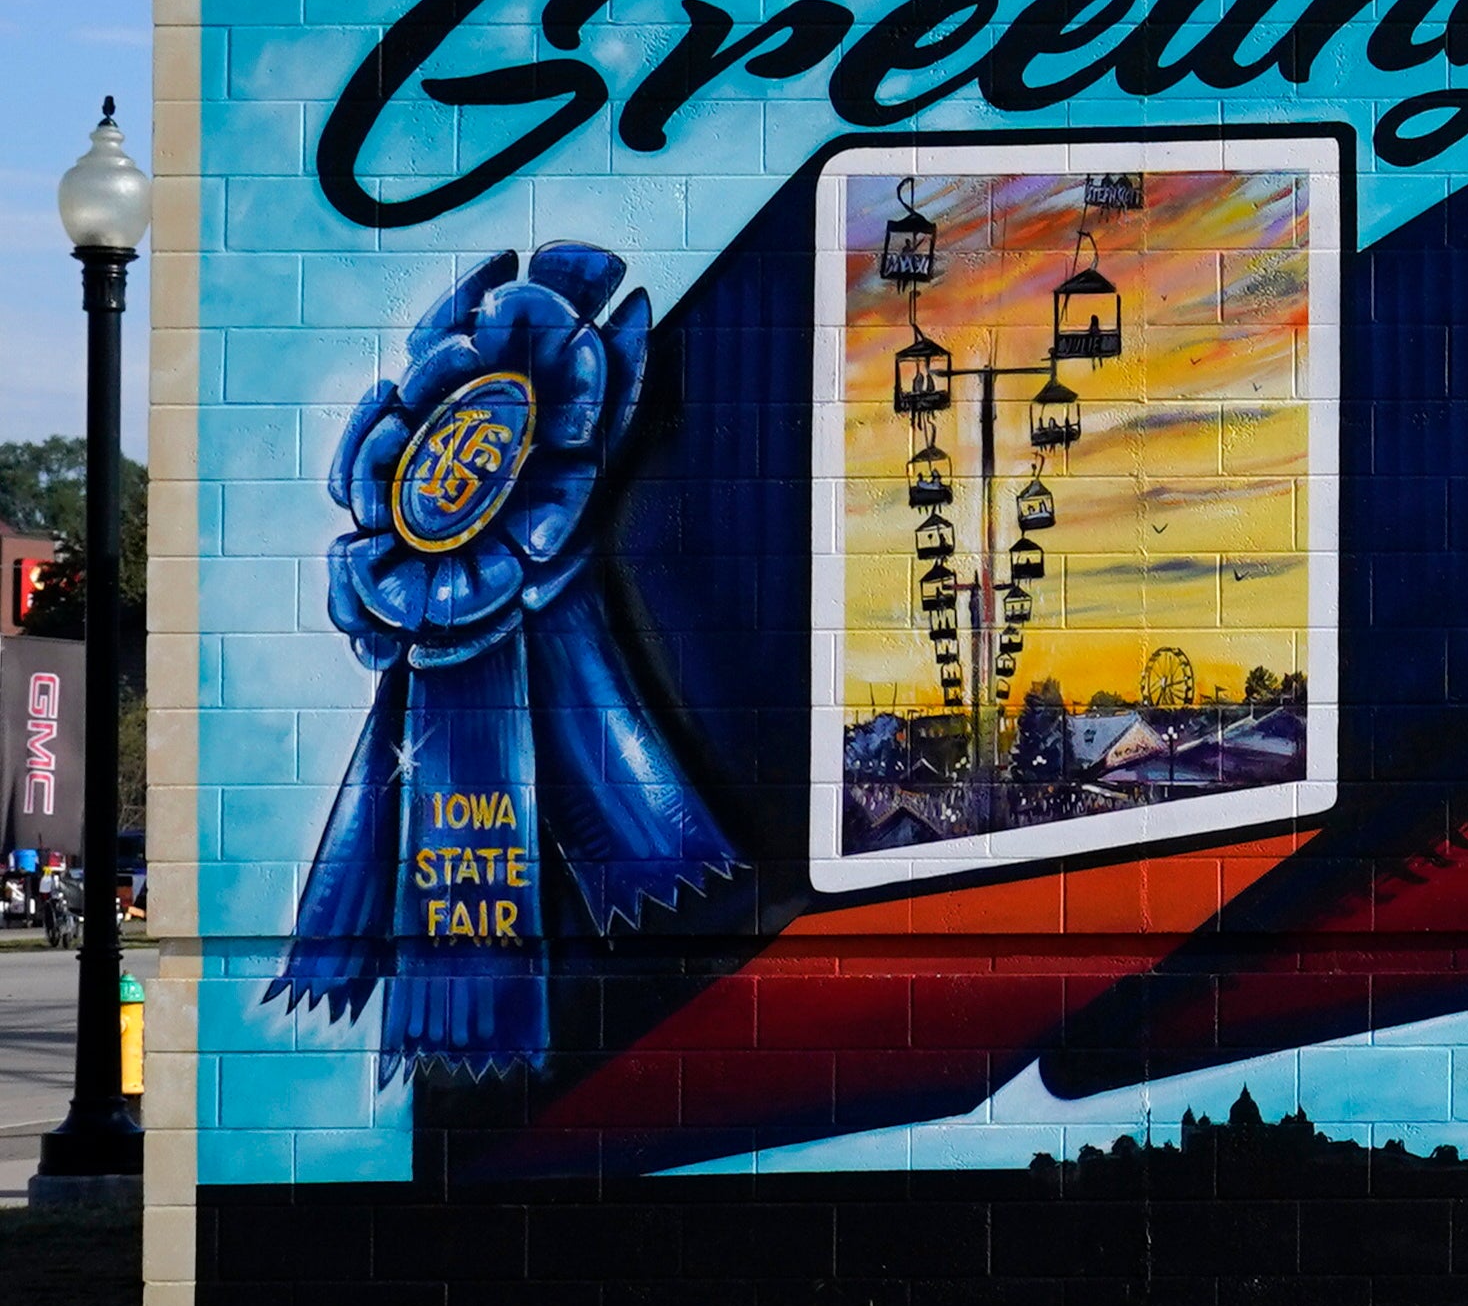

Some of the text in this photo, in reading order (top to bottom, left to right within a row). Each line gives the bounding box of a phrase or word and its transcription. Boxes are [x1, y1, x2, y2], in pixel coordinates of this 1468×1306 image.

[23, 672, 60, 815] GMC
[432, 791, 517, 831] IOWA
[414, 847, 532, 890] STATE
[427, 899, 519, 939] FAIR
